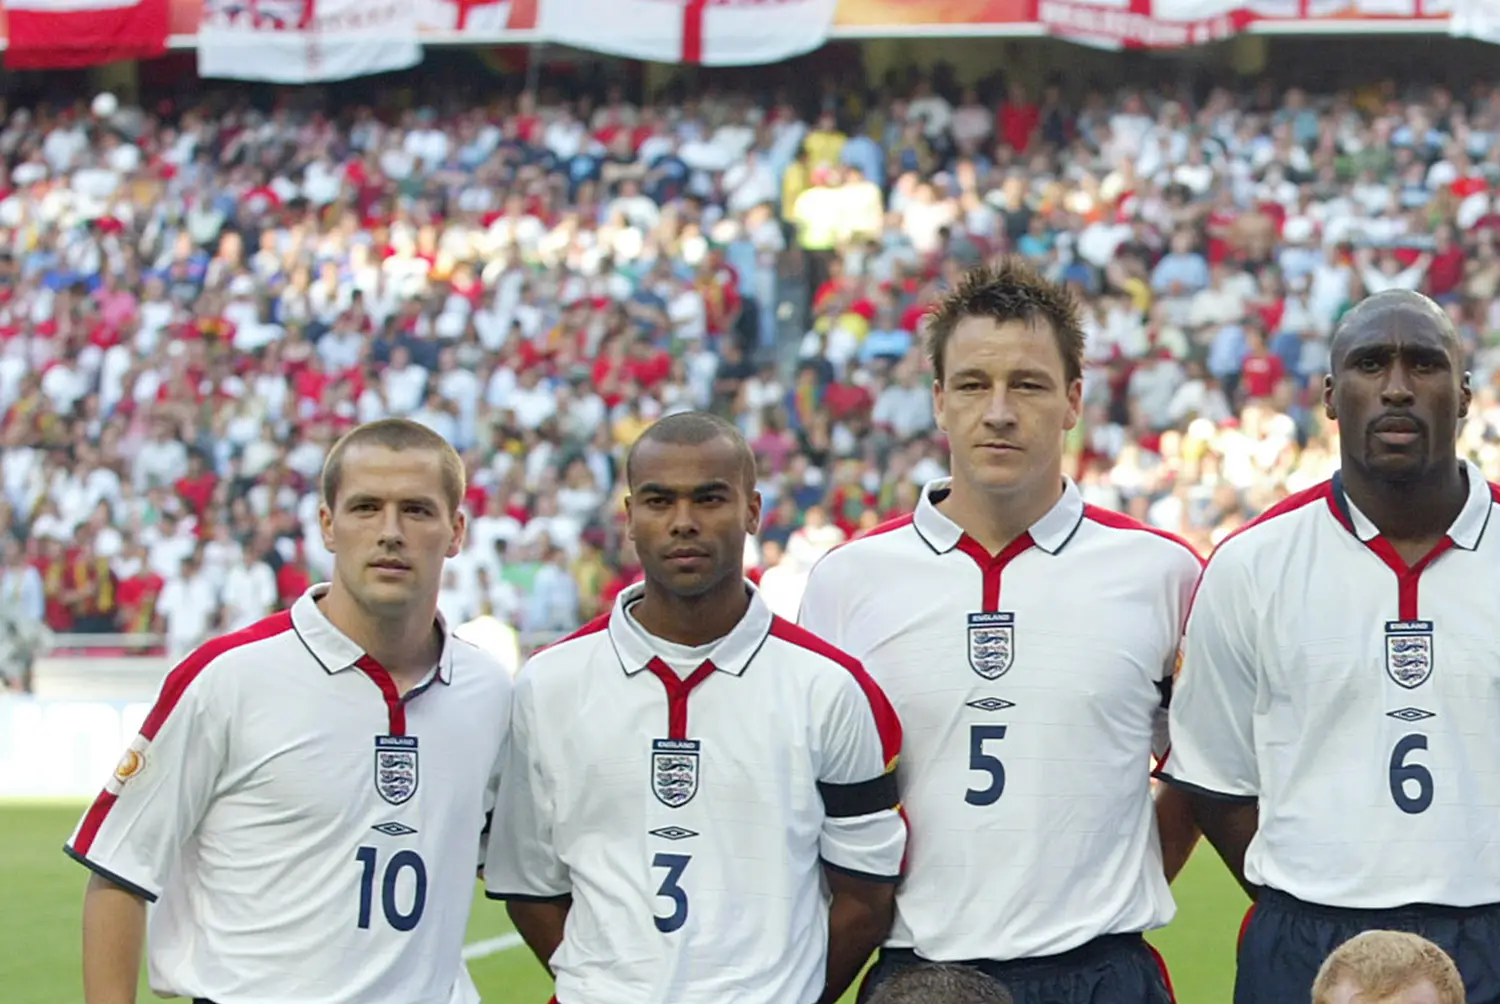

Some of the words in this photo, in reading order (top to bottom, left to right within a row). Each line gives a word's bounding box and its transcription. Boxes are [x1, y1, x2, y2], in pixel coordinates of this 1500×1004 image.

[972, 614, 1010, 623] ENGLAND
[658, 741, 695, 750] ENGLAND
[965, 724, 1007, 807] 5
[1389, 733, 1435, 814] 6
[355, 846, 428, 932] 10
[652, 853, 693, 934] 3
